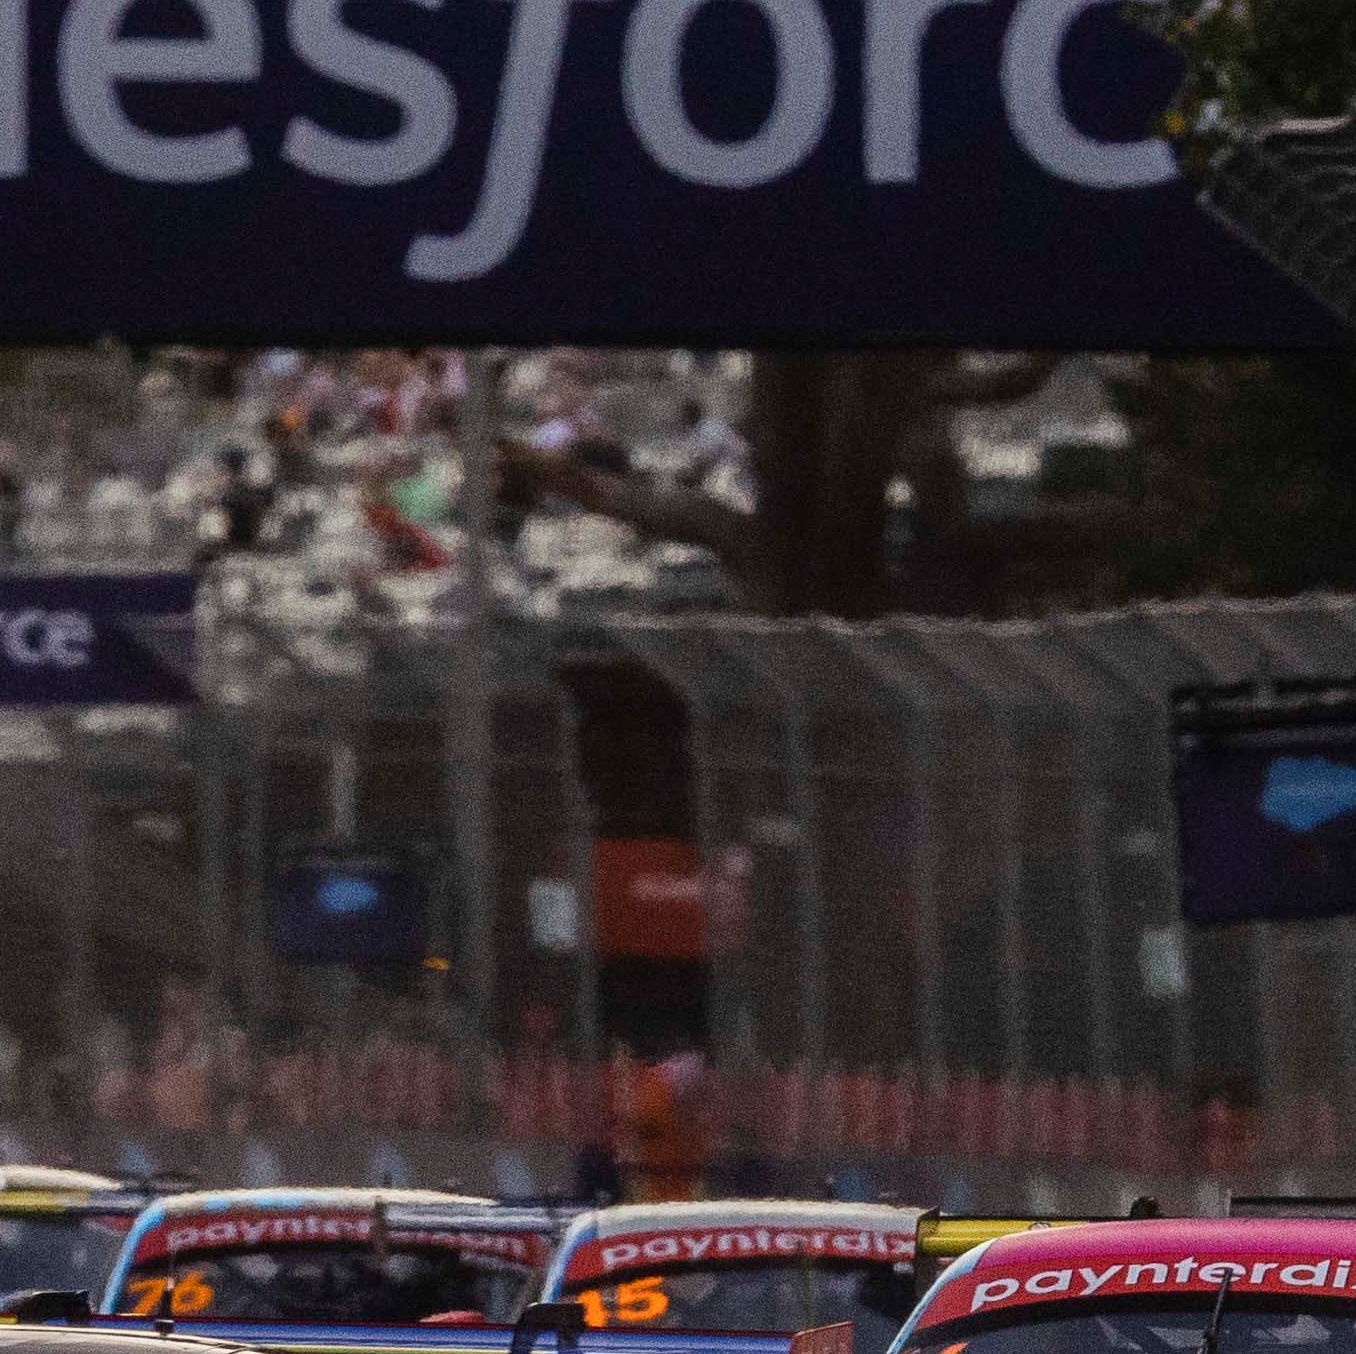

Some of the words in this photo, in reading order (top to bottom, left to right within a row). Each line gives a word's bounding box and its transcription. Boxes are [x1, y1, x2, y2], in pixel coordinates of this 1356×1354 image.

[602, 1228, 917, 1272] paynterdix
[128, 1272, 213, 1316] 76
[576, 1276, 669, 1328] 15
